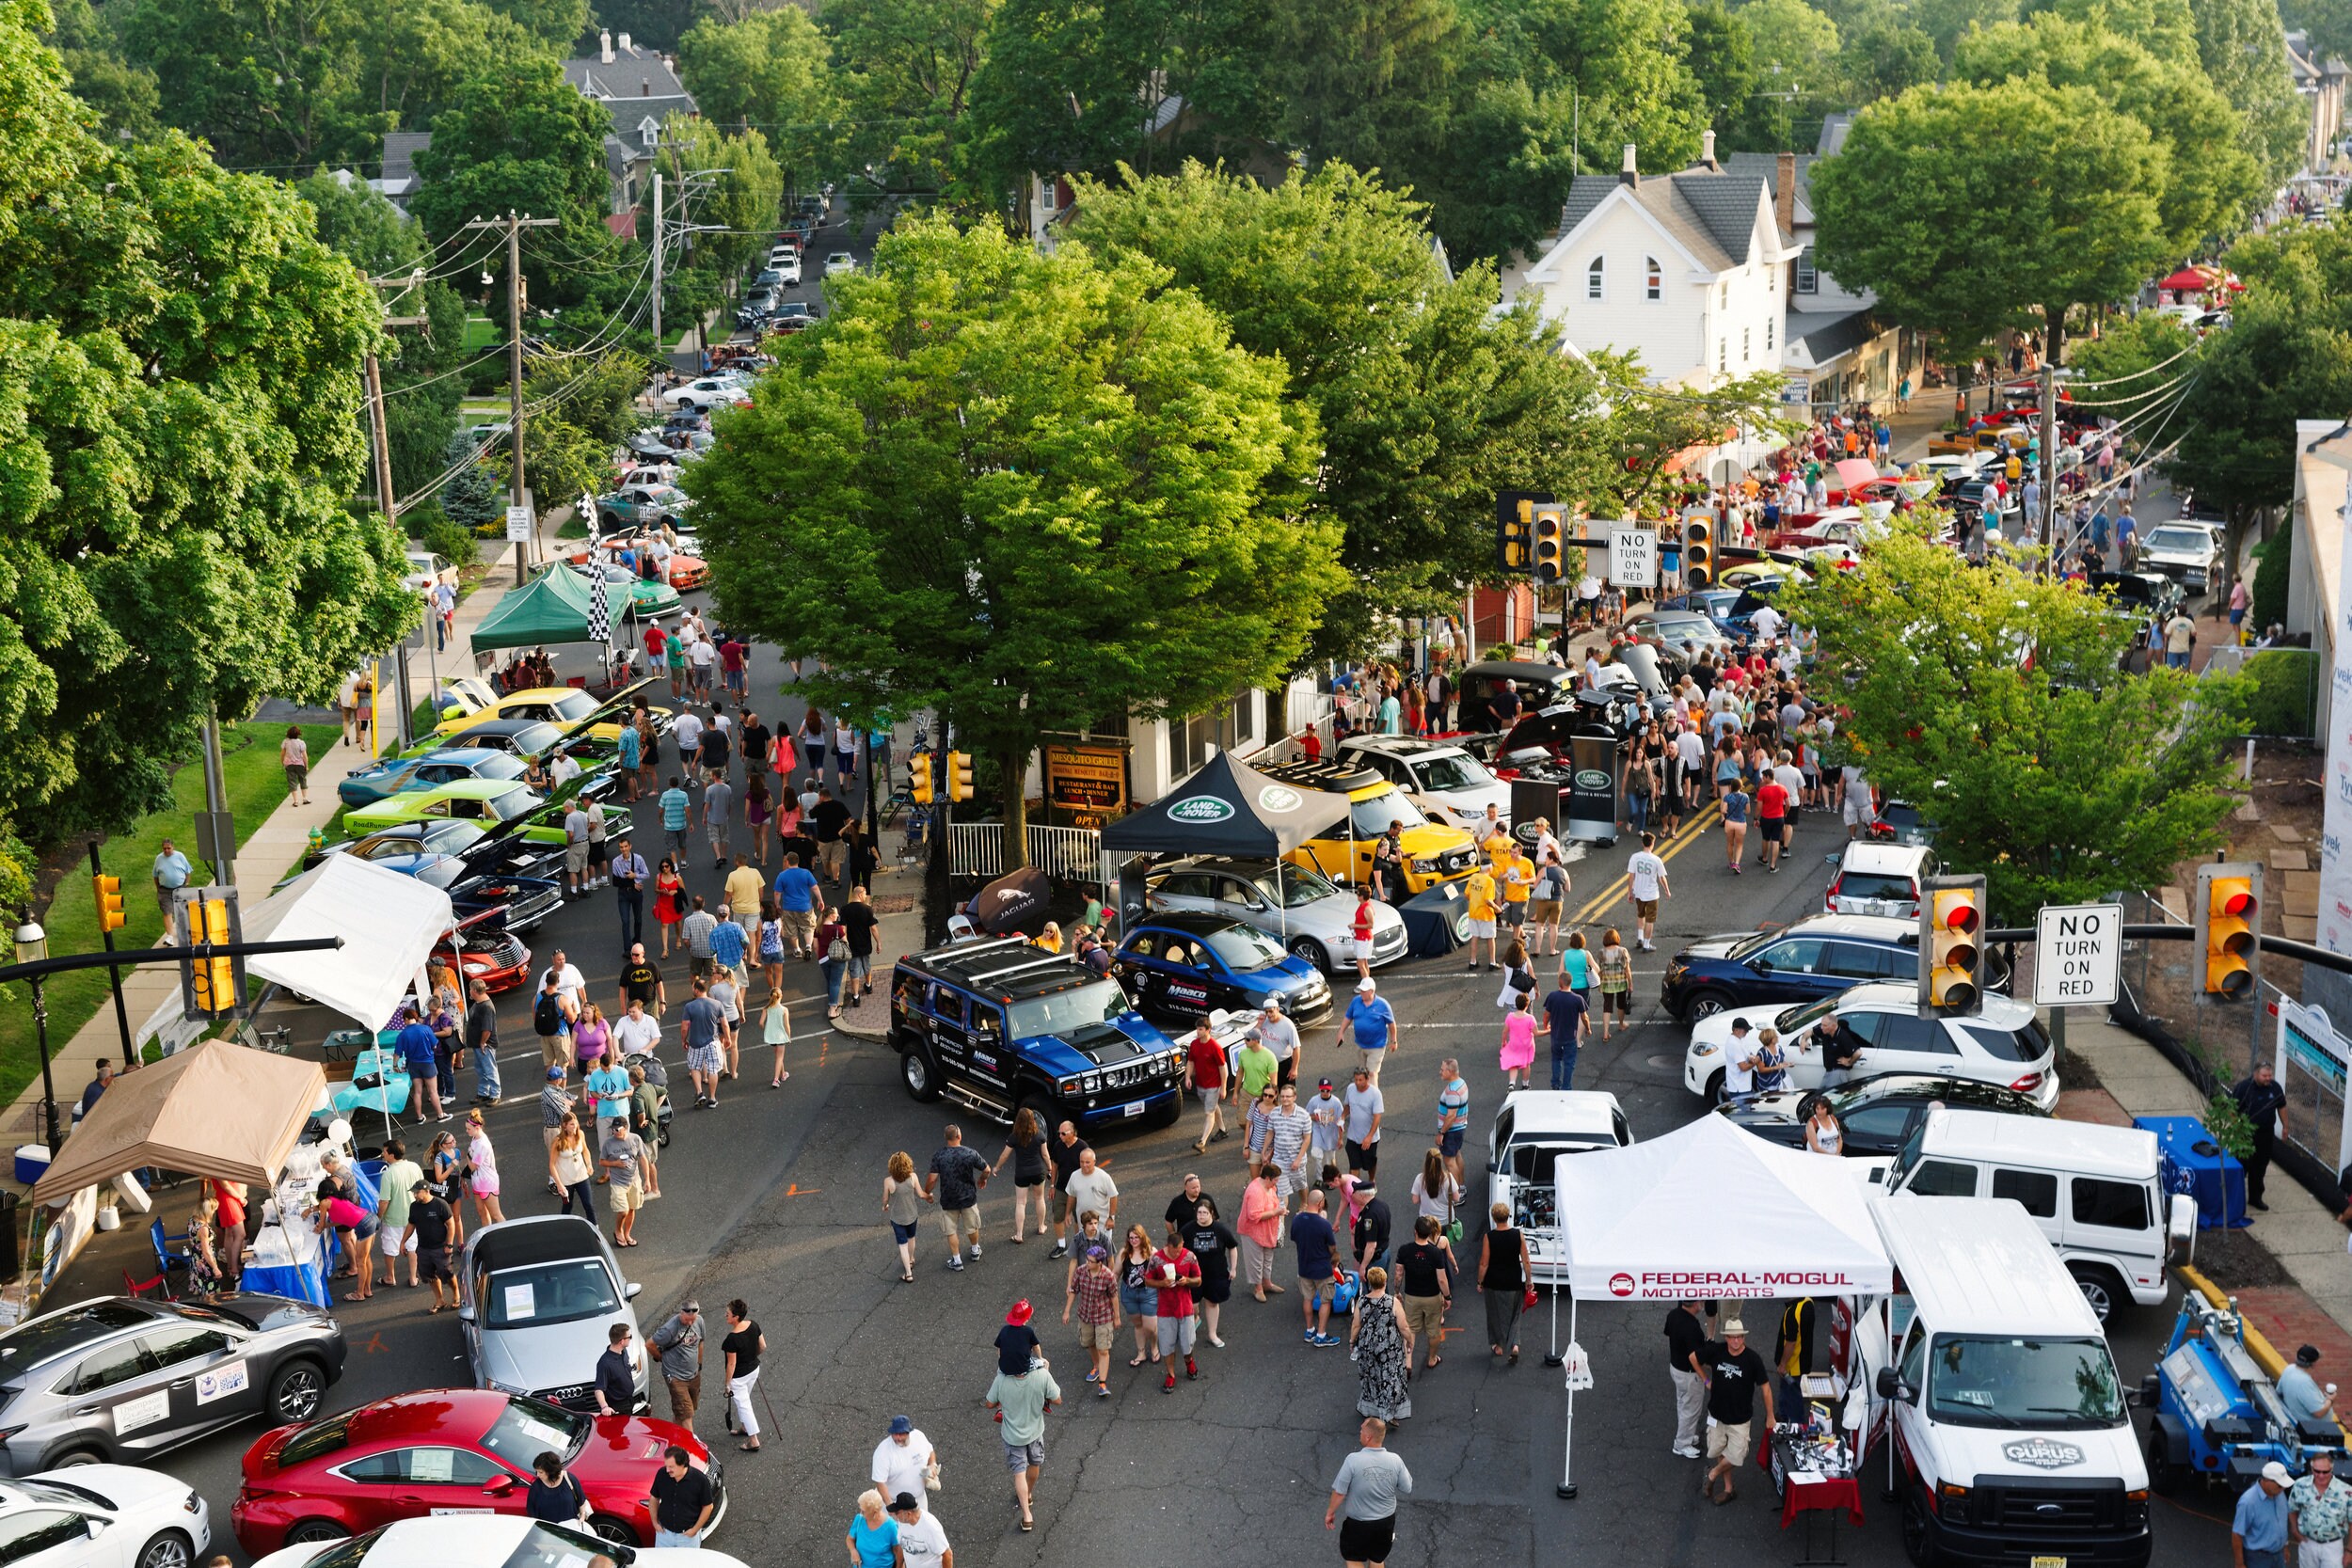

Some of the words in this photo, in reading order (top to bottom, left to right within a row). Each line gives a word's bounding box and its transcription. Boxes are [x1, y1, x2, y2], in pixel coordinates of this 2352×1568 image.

[1621, 534, 1645, 546] NO
[1619, 549, 1646, 558] TURN
[1625, 561, 1640, 569] ON
[1623, 572, 1643, 580] RED
[1052, 752, 1091, 765] MESQUITO
[1093, 756, 1119, 767] GRILLE
[1058, 780, 1095, 789] RESTAURANT
[1095, 782, 1102, 790] &
[1183, 801, 1215, 810] LAND
[1182, 809, 1221, 818] ROVER
[1075, 815, 1101, 826] OPEN
[1637, 860, 1653, 876] 66
[1470, 883, 1484, 893] STAFF
[999, 898, 1035, 921] JAGUAR
[2059, 914, 2100, 936] NO
[2055, 941, 2101, 956] TURN
[2064, 960, 2090, 975] ON
[1168, 985, 1207, 999] Maaco
[2059, 980, 2093, 996] RED
[973, 1050, 997, 1065] Maaco
[1642, 1272, 1853, 1285] FEDERAL-MOGUL
[1642, 1287, 1774, 1298] MOTORPARTS
[220, 1371, 244, 1386] SUNDAY
[220, 1382, 234, 1393] SEPT
[119, 1396, 163, 1414] Thompson
[2007, 1446, 2080, 1460] GURUS
